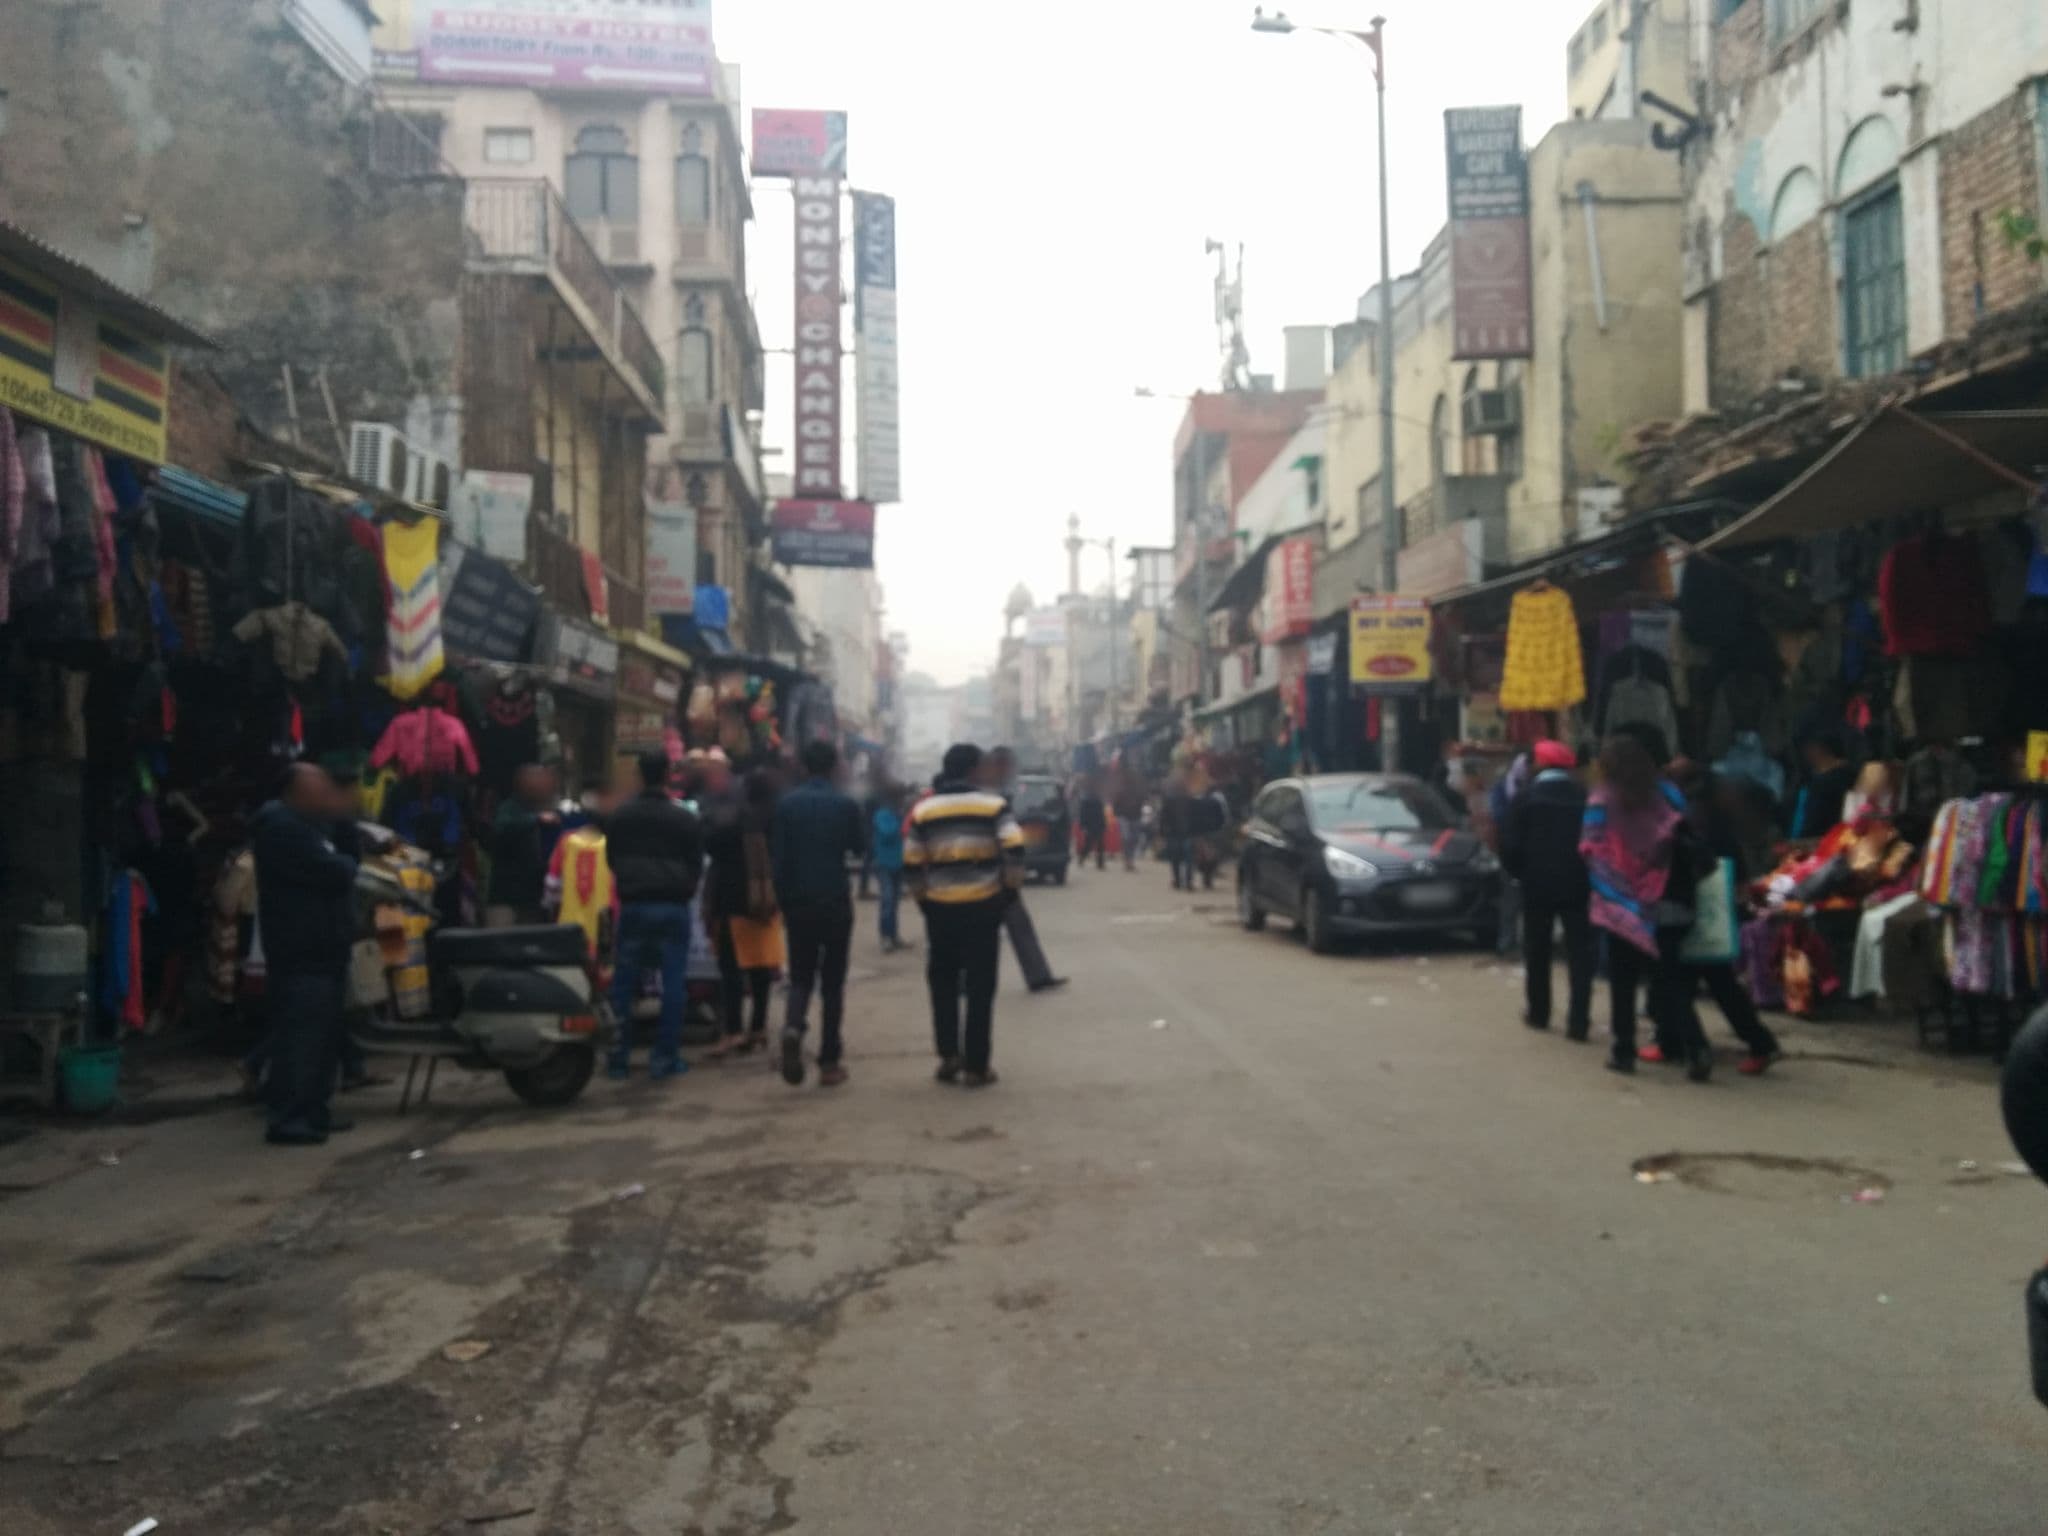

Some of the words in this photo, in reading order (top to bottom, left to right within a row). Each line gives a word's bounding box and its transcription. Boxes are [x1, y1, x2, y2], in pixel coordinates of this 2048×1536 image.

[444, 13, 580, 36] BUDGET
[590, 21, 693, 42] HOTEL
[430, 34, 537, 52] DORMITORY
[1466, 154, 1505, 174] CAFE
[797, 178, 835, 292] MONEY
[800, 322, 834, 488] CHANGER
